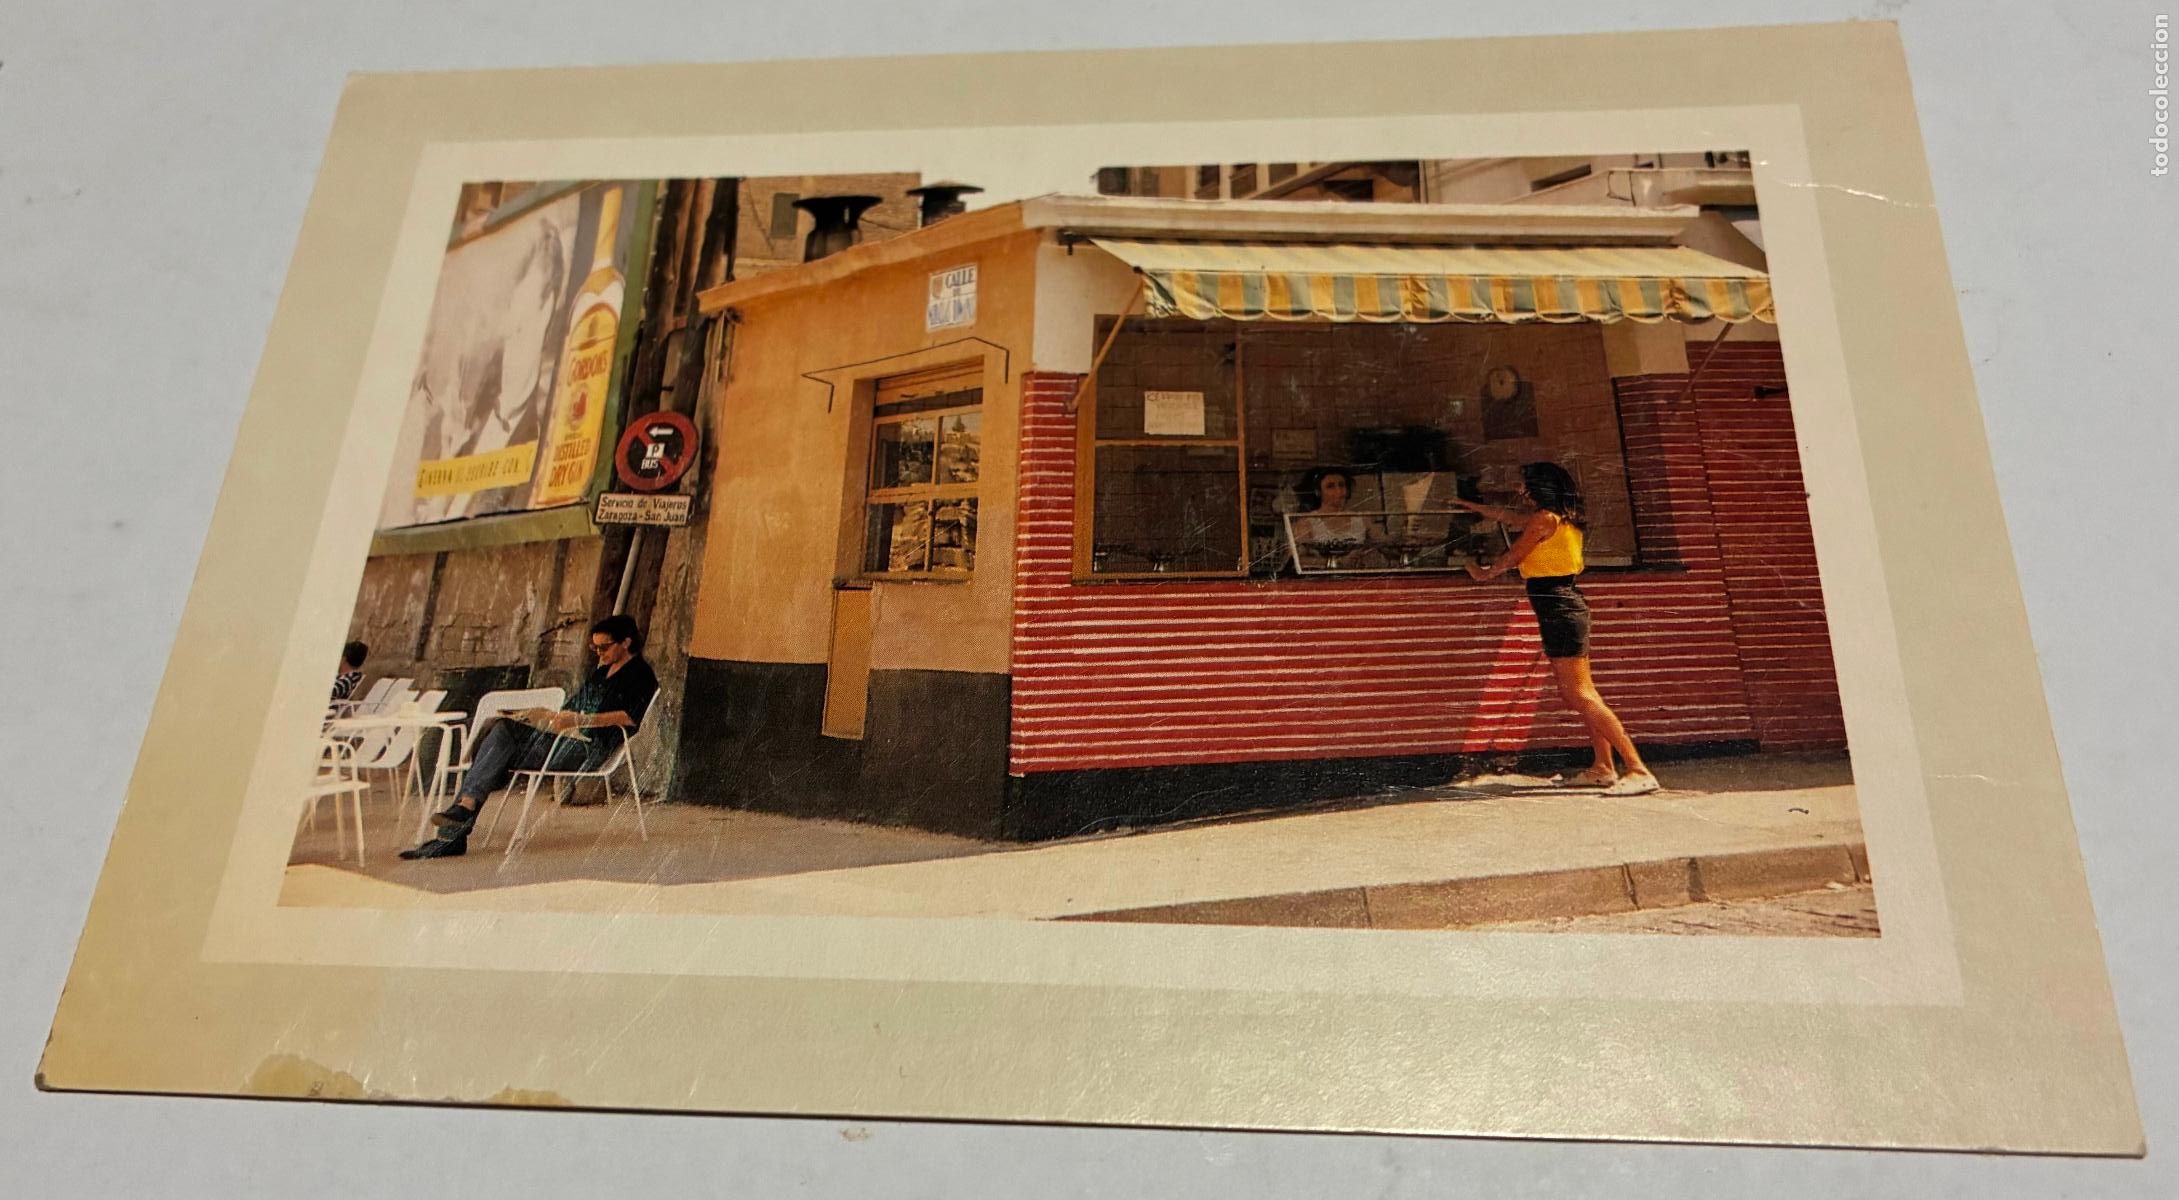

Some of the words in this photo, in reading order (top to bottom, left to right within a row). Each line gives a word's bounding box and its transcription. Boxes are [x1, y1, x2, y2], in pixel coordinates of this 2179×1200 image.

[946, 269, 975, 288] CALLE
[553, 438, 591, 462] DISTILLED
[641, 459, 658, 470] BUS
[549, 462, 568, 488] DRY
[568, 460, 584, 484] GIN
[601, 496, 634, 508] Servicio
[637, 497, 647, 508] de
[653, 498, 687, 512] Viajeros
[644, 510, 661, 522] San
[664, 511, 685, 523] Juan
